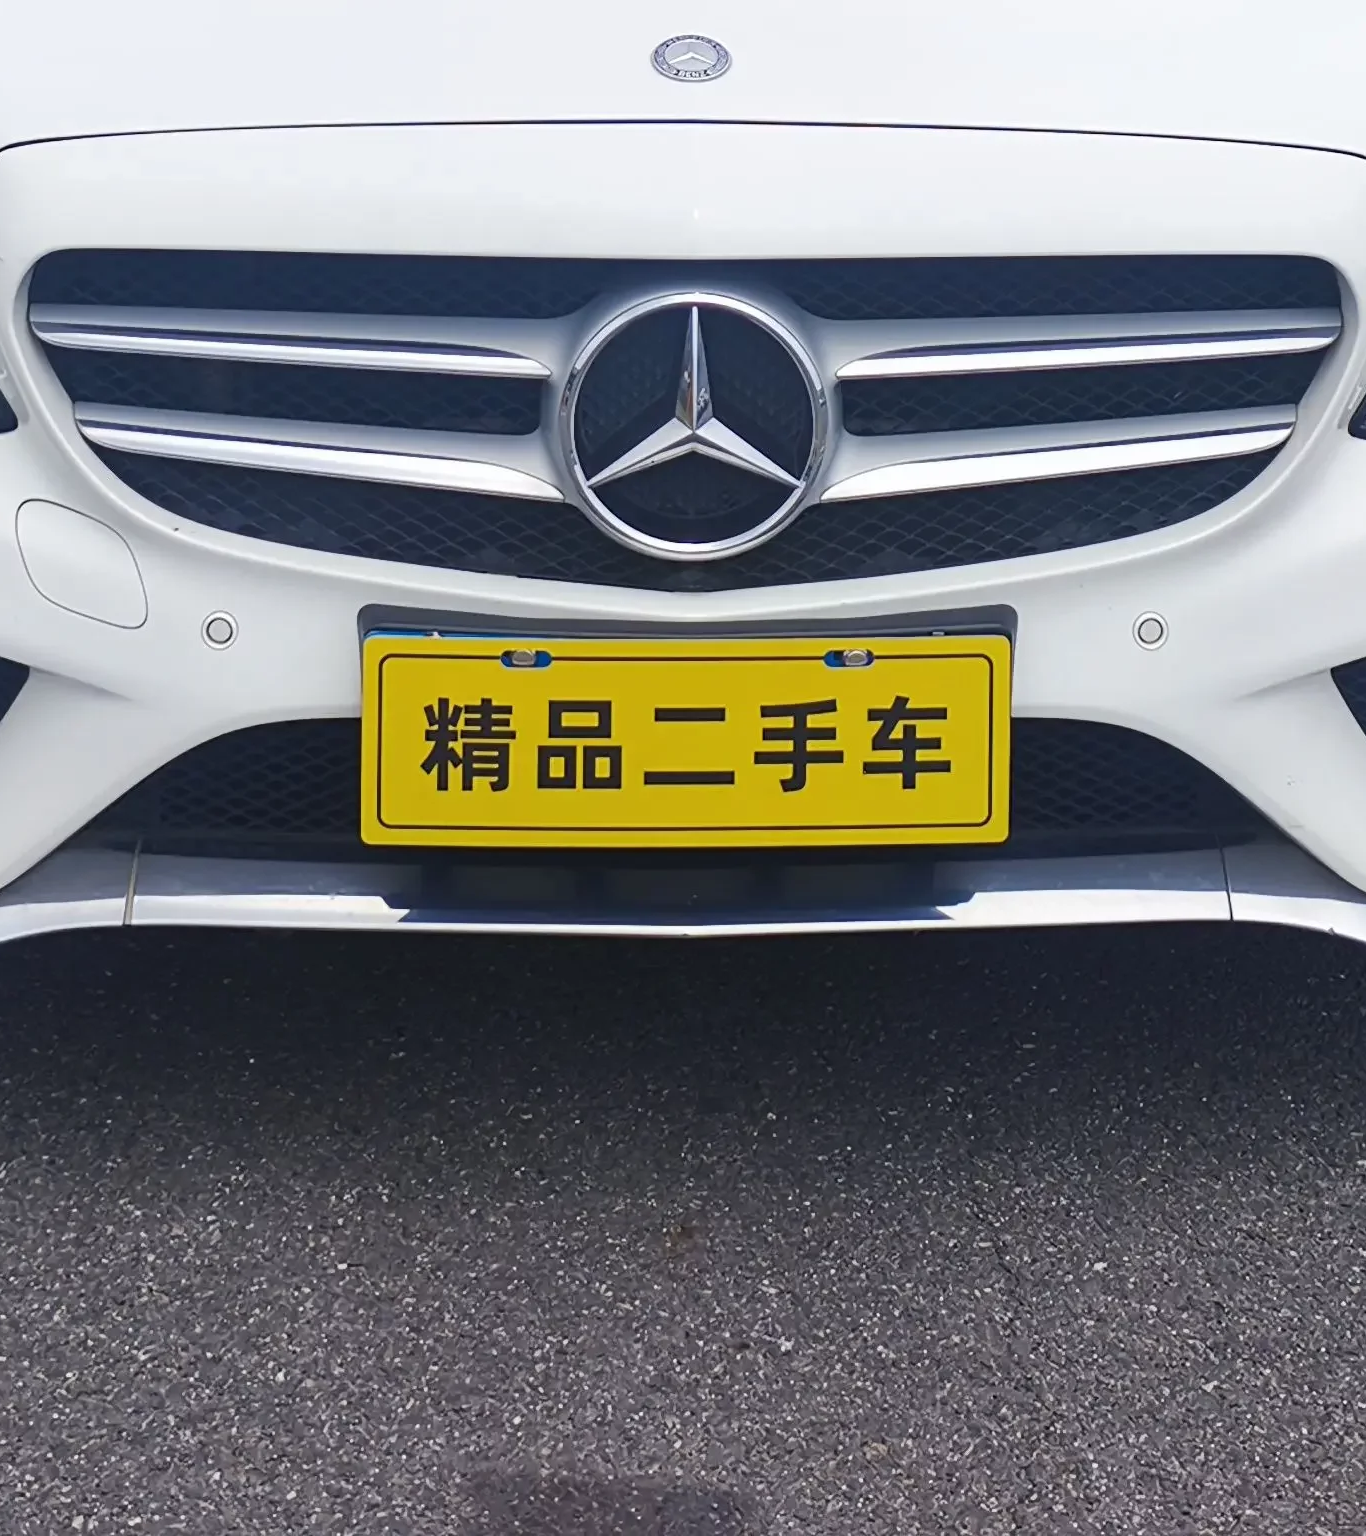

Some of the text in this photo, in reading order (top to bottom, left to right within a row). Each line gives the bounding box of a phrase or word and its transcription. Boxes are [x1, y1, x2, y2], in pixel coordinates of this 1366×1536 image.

[421, 695, 952, 793] 精品二手车
